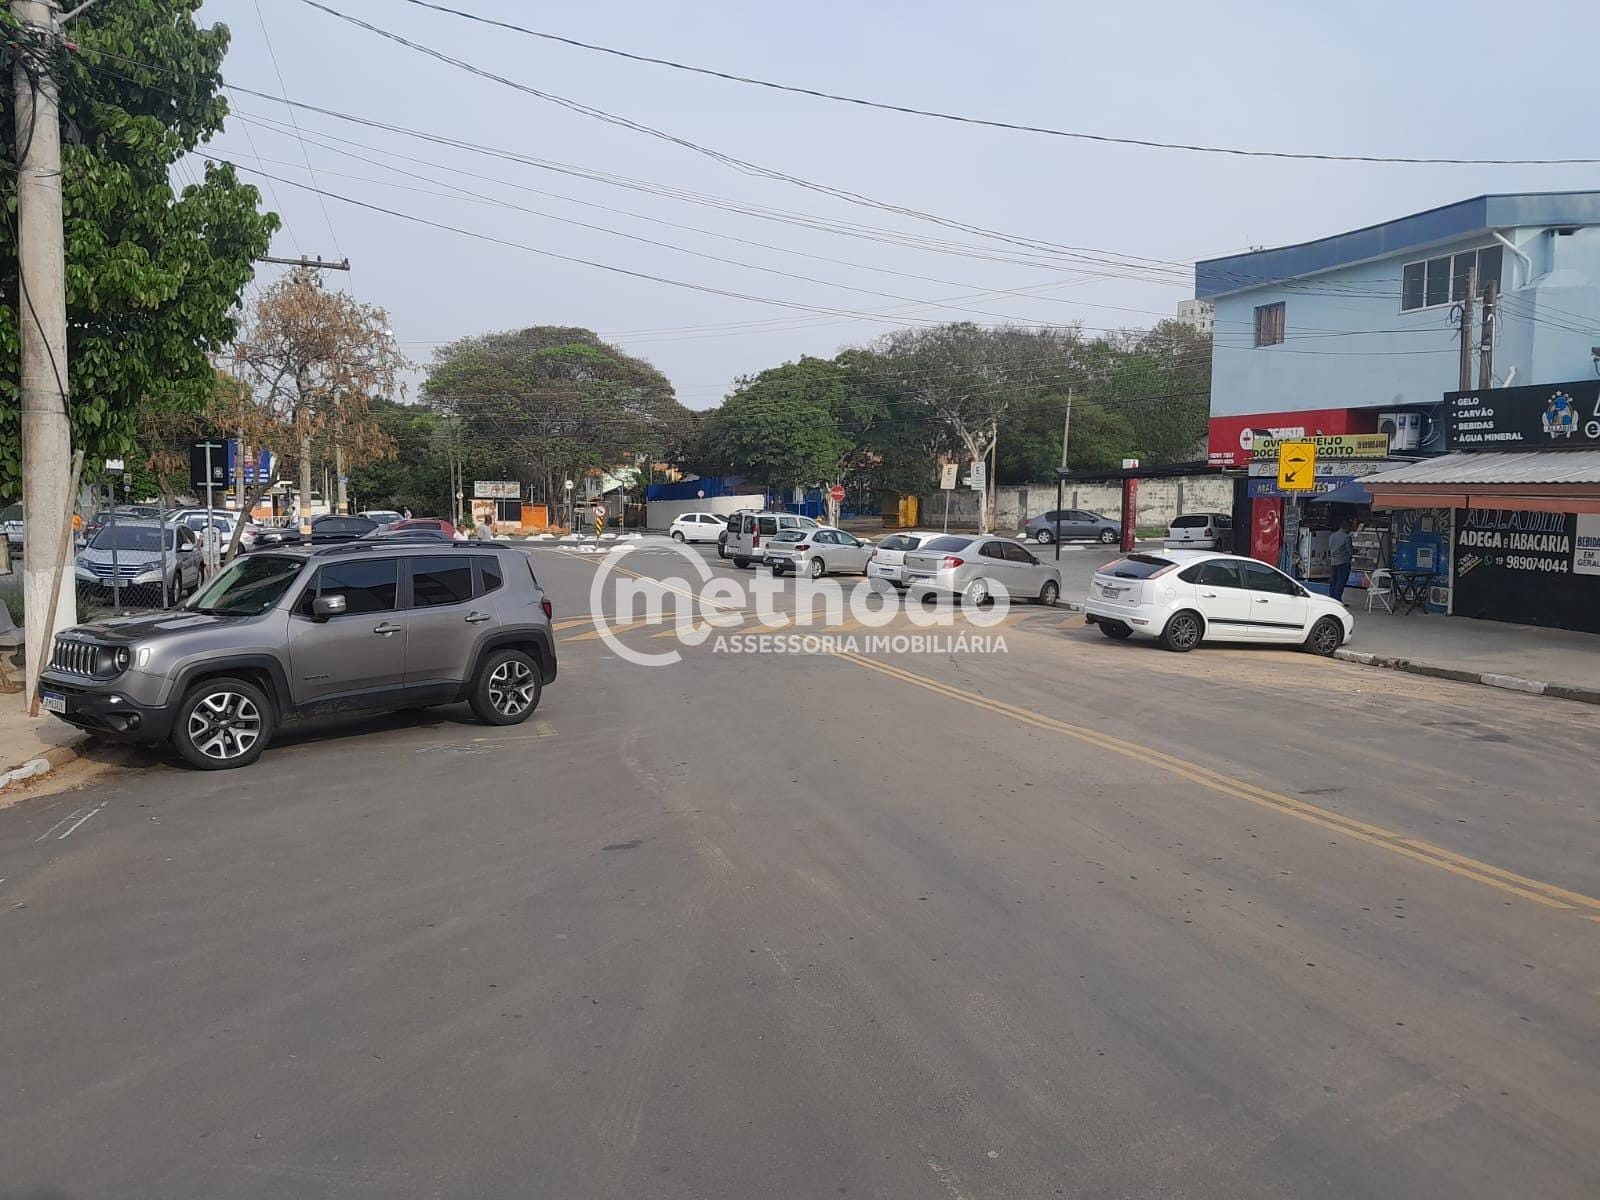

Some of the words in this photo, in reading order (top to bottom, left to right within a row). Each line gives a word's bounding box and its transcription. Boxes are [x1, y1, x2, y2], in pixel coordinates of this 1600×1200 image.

[1457, 397, 1480, 406] GELO
[1458, 407, 1494, 418] CARVÃO
[1458, 421, 1495, 431] BEBIDAS
[1460, 432, 1483, 442] ÁGUA
[1484, 432, 1524, 441] MINERAL
[1459, 530, 1502, 549] ADEGA
[1503, 537, 1509, 549] e
[1509, 532, 1570, 553] TABACARIA
[1584, 551, 1595, 559] EM
[1506, 555, 1569, 573] 989074044
